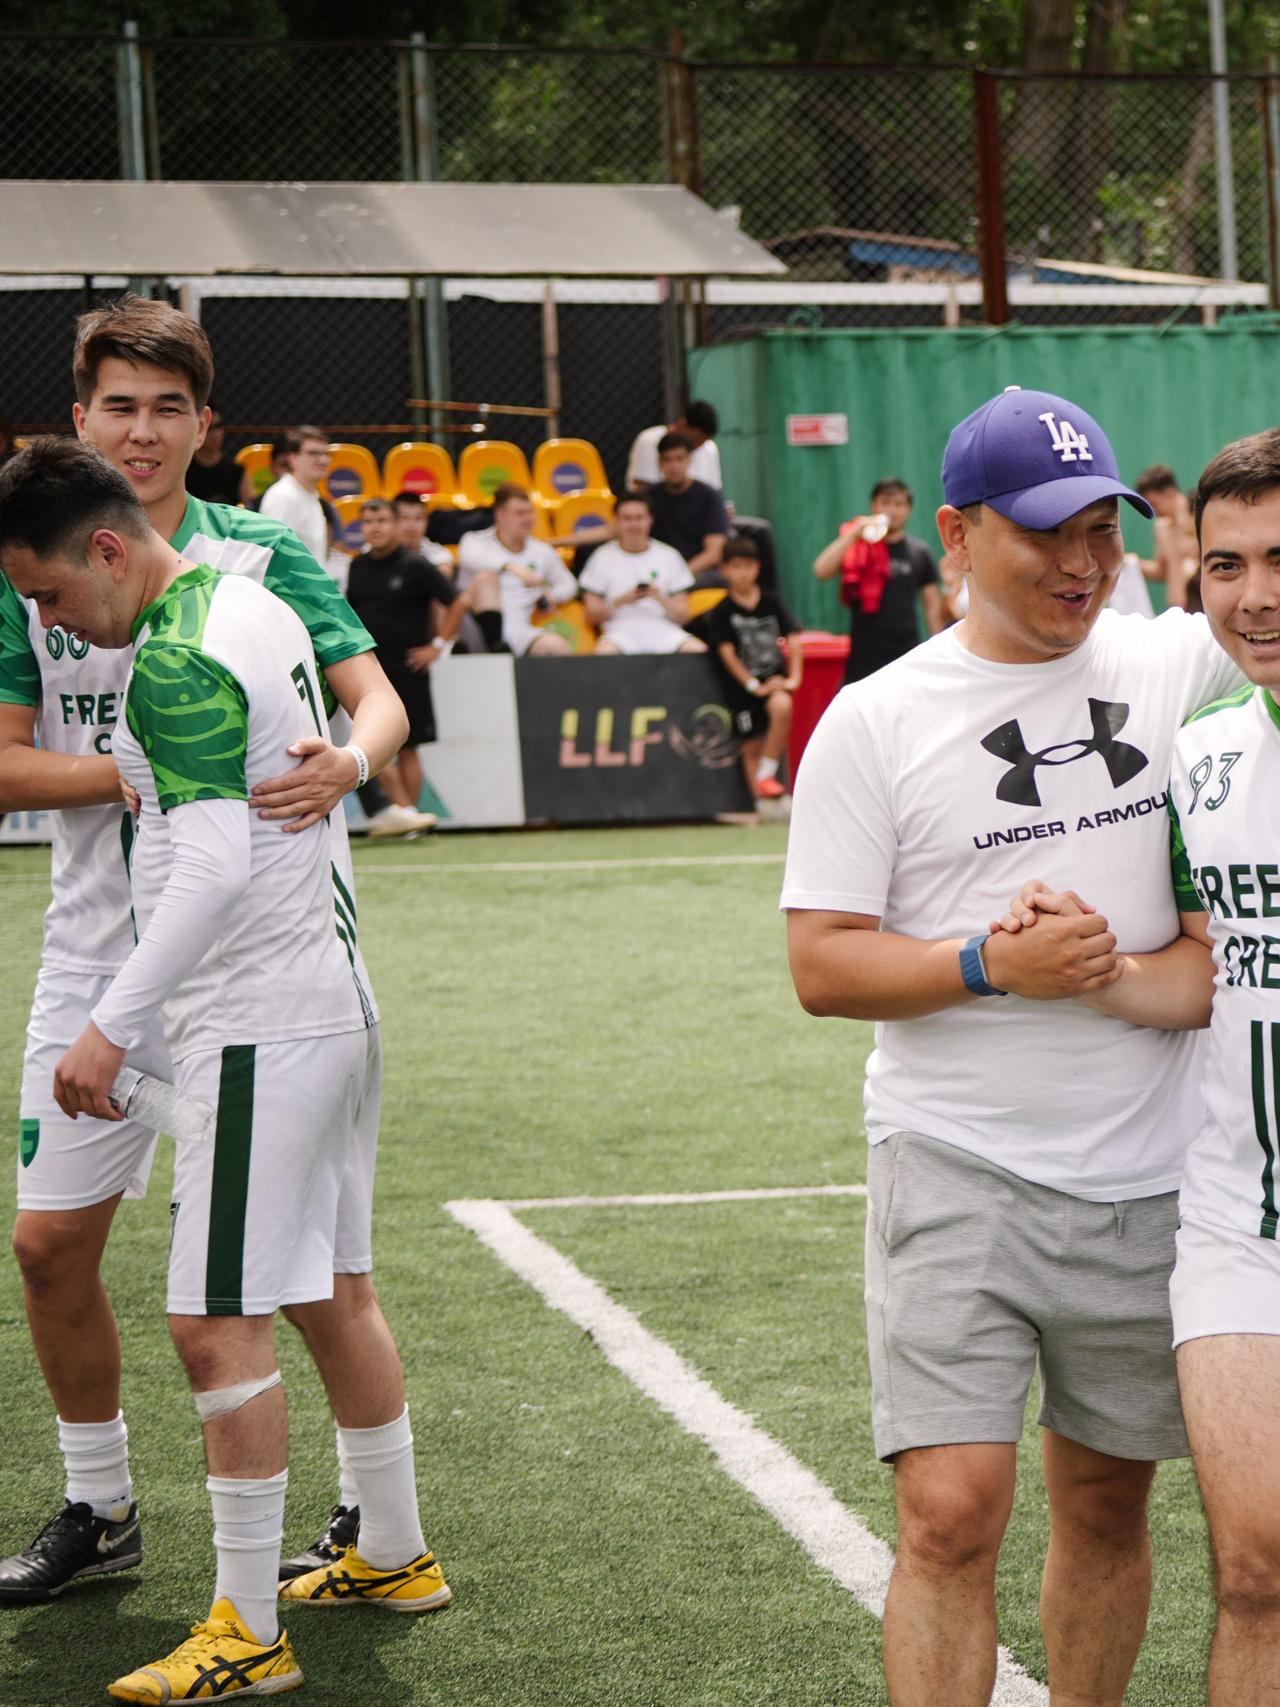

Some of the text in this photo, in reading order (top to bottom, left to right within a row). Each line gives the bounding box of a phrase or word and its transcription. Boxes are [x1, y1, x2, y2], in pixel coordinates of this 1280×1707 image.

[1038, 412, 1093, 462] LA
[60, 692, 124, 725] FRE
[559, 706, 667, 768] LLF
[1188, 751, 1244, 814] 93
[973, 820, 1066, 850] UNDER
